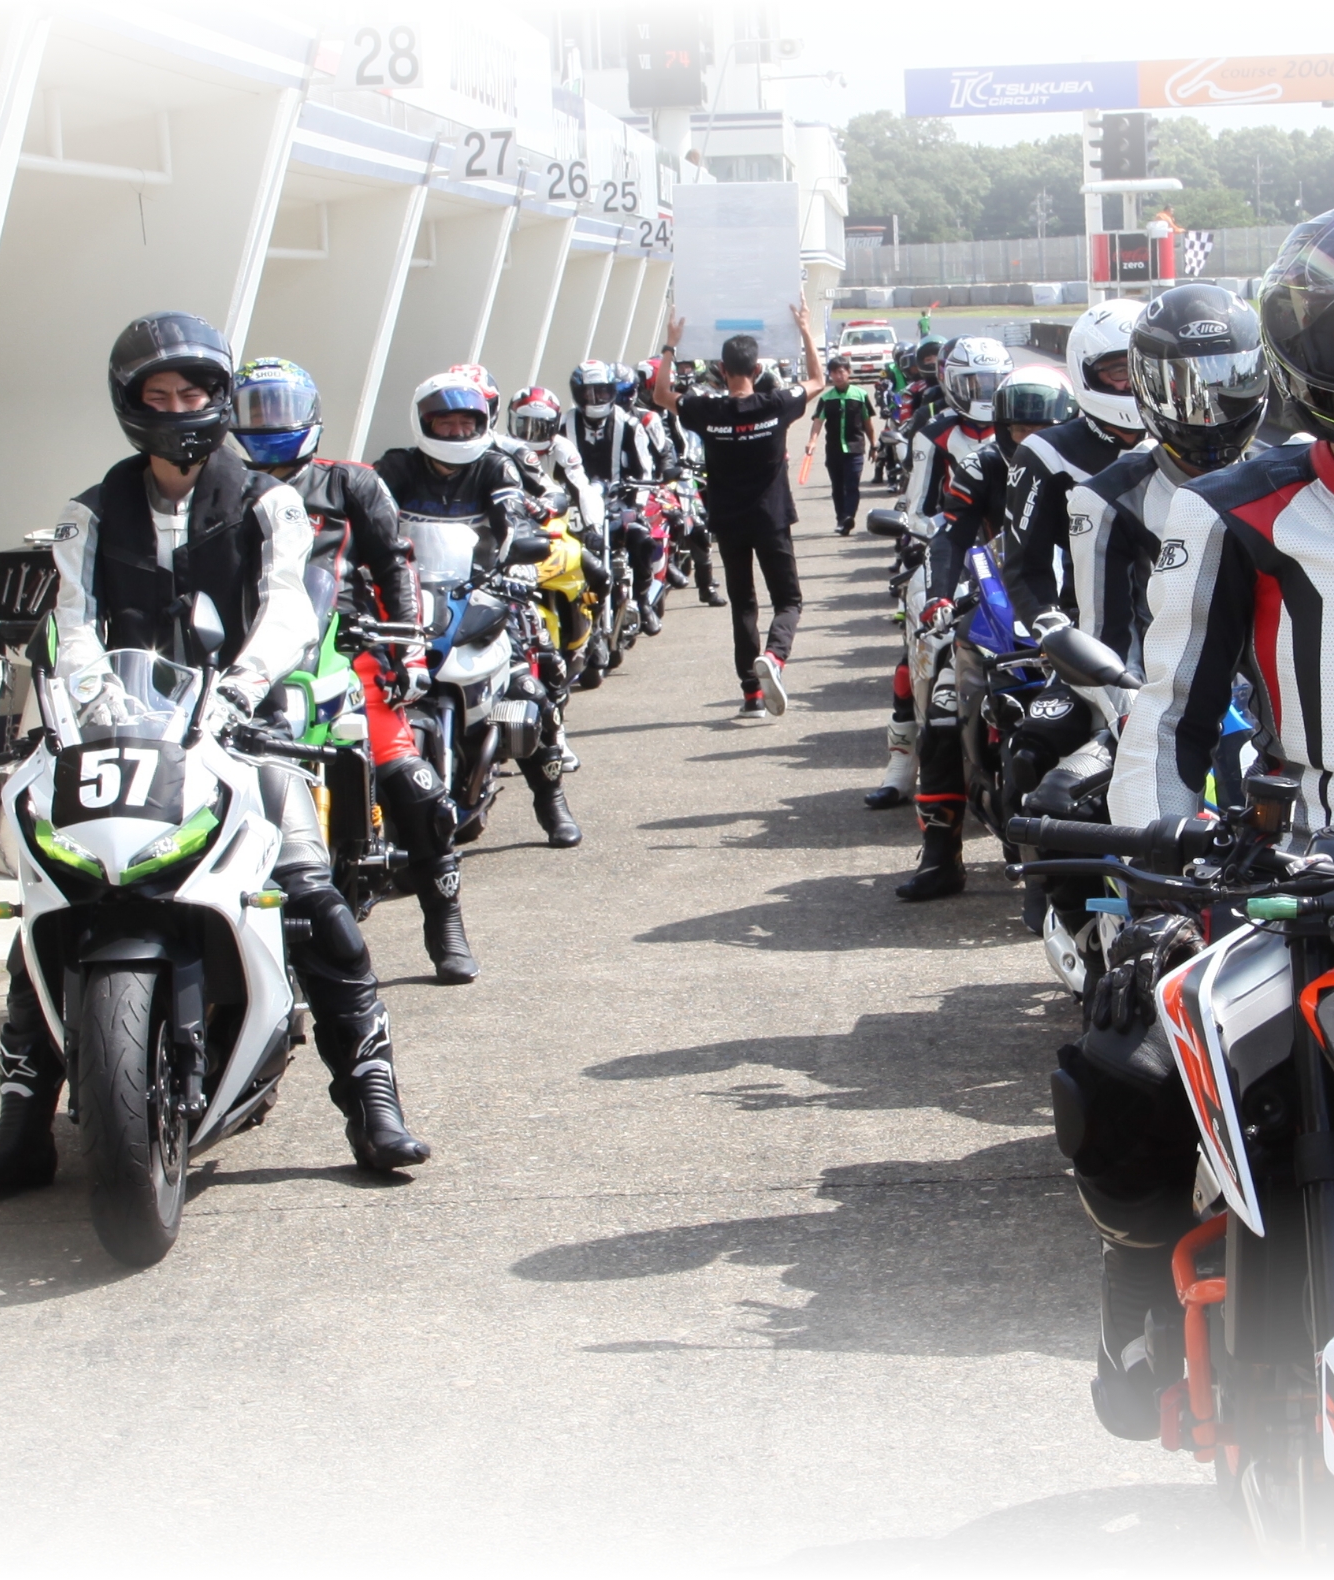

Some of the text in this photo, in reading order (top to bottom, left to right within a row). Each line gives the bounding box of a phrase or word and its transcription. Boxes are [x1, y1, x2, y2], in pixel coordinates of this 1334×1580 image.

[354, 25, 419, 86] 28
[665, 50, 690, 68] 74
[1220, 67, 1277, 79] course
[993, 81, 1094, 96] TSUKUBA
[465, 130, 514, 177] 27
[546, 160, 589, 200] 26
[602, 180, 638, 213] 25
[639, 219, 670, 249] 24
[1123, 261, 1145, 270] zero
[1186, 322, 1224, 337] X-lite
[974, 354, 999, 363] Arai
[255, 370, 282, 380] SHOEI
[1019, 475, 1042, 530] BERIK
[79, 748, 159, 809] 57
